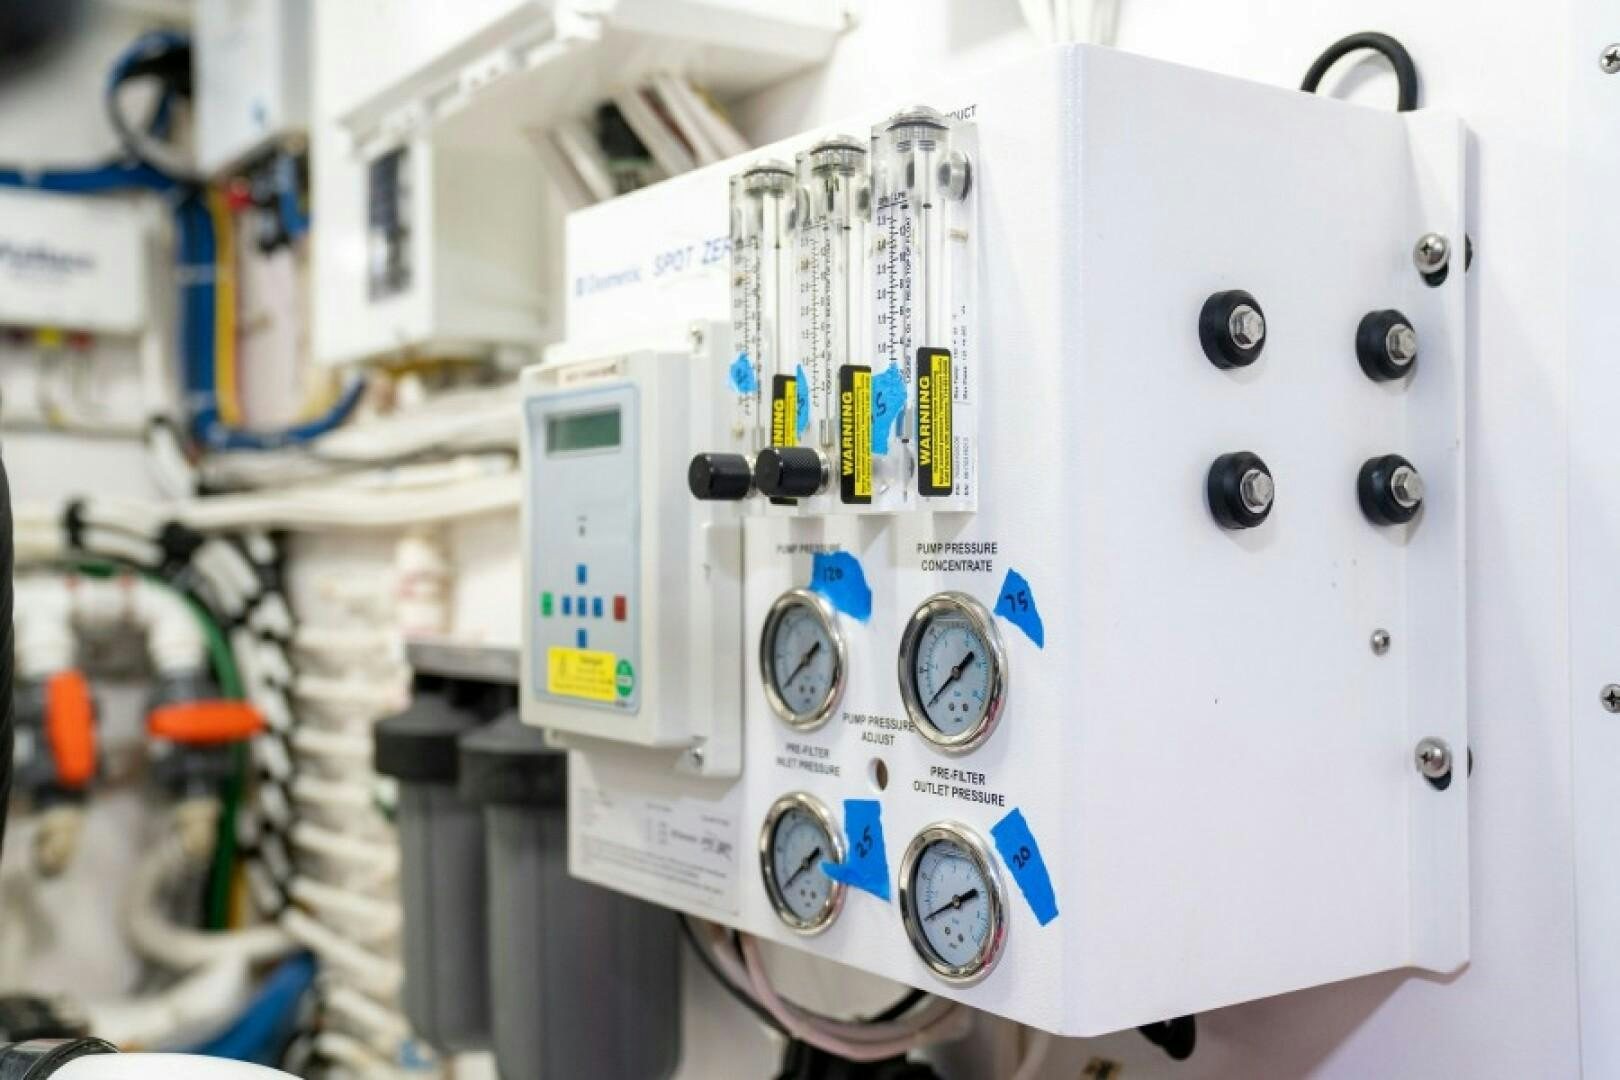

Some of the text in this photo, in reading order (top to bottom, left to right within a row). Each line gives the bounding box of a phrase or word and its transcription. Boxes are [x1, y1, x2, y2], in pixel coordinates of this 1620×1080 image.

[919, 375, 931, 466] WARNING
[842, 391, 854, 476] WARNING
[917, 542, 998, 555] PUMP PRESSURE
[921, 559, 993, 572] CONCENTRATE
[1005, 590, 1028, 613] 75
[842, 712, 915, 733] PUMP PRESSURE
[861, 731, 896, 746] ADJUST
[799, 759, 841, 777] PRESSURE
[930, 766, 986, 786] PRE-FILTER
[913, 780, 1006, 807] OUTLET PRESSURE
[856, 825, 874, 858] 25
[1012, 845, 1032, 870] 20
